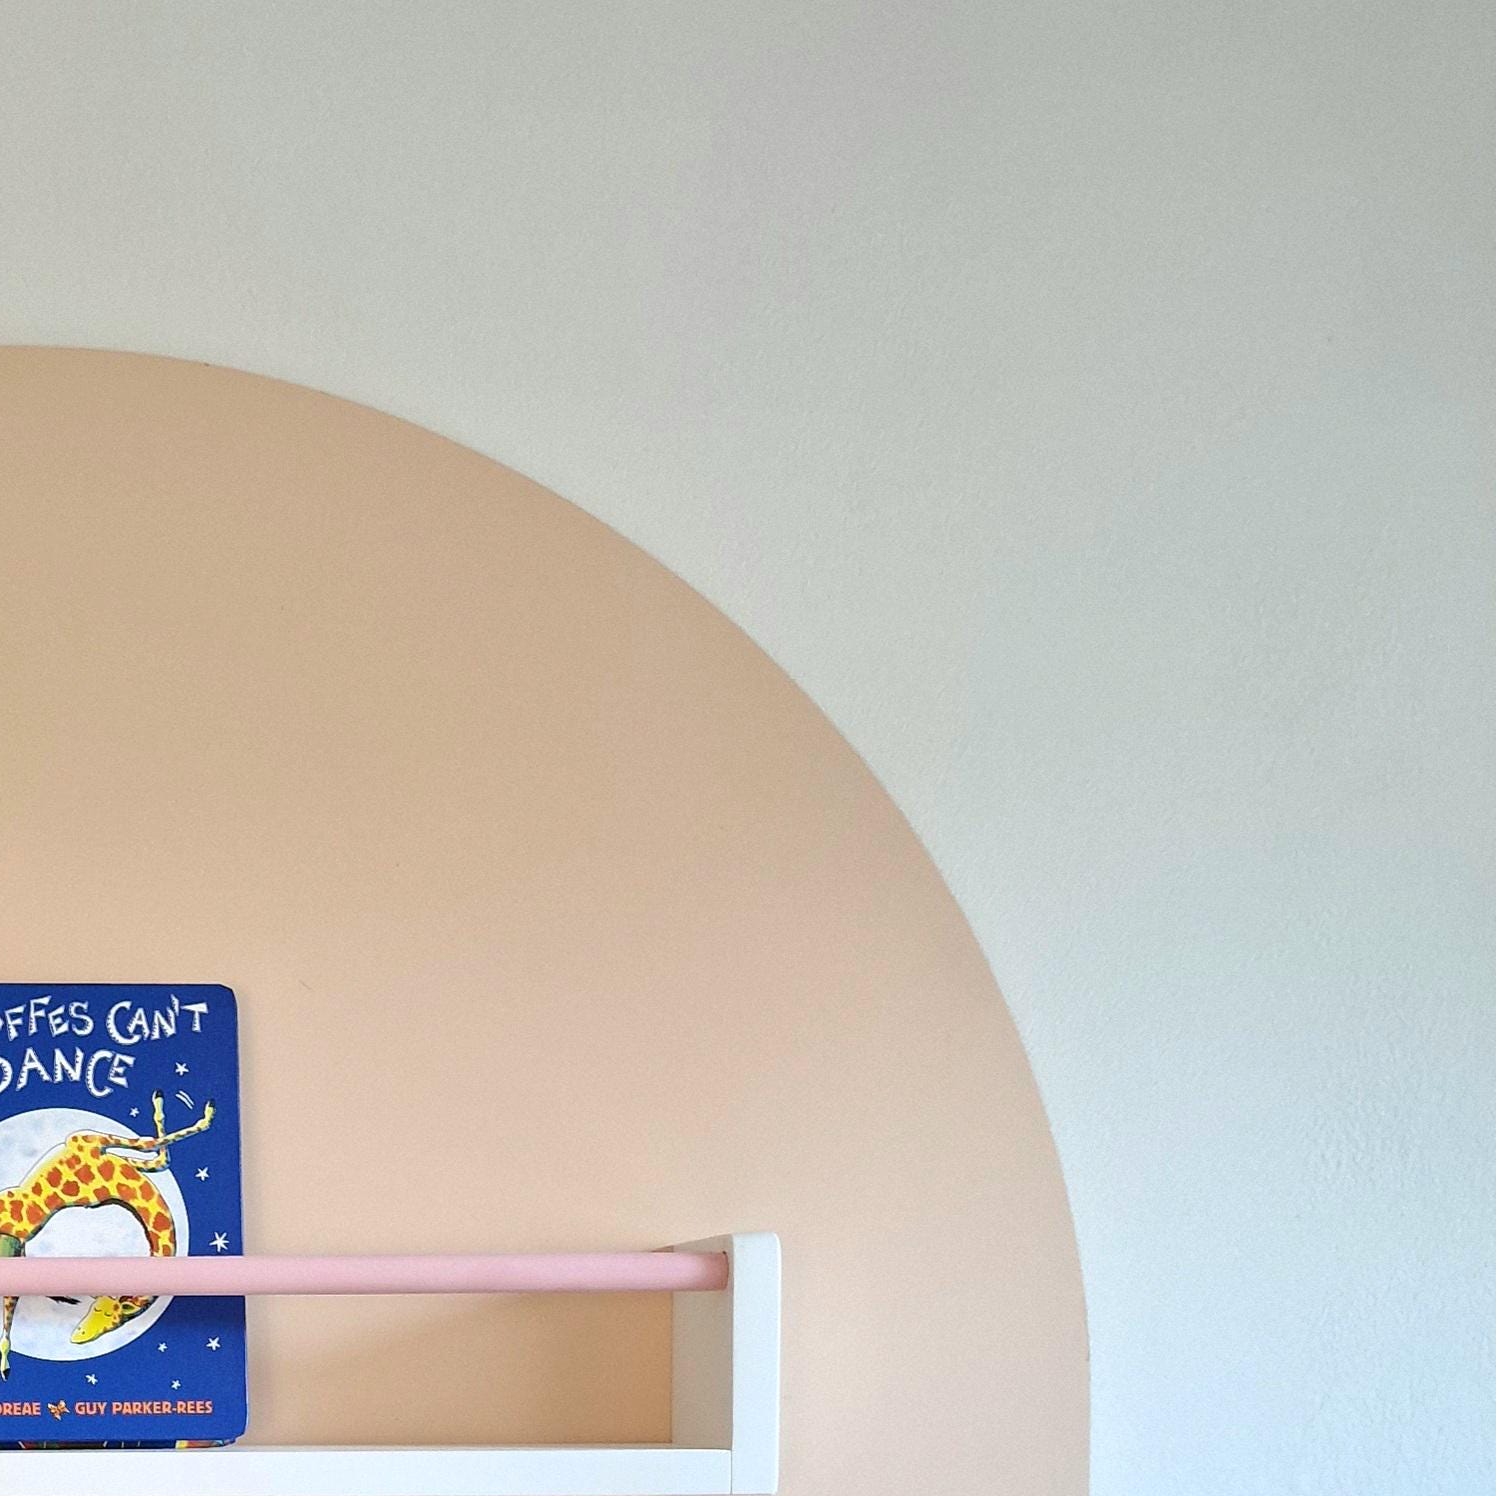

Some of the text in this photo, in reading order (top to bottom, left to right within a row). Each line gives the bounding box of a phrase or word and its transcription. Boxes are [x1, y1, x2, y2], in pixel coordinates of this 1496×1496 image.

[105, 993, 209, 1046] CAN'T
[75, 1400, 213, 1415] GUY PARKER-REES
